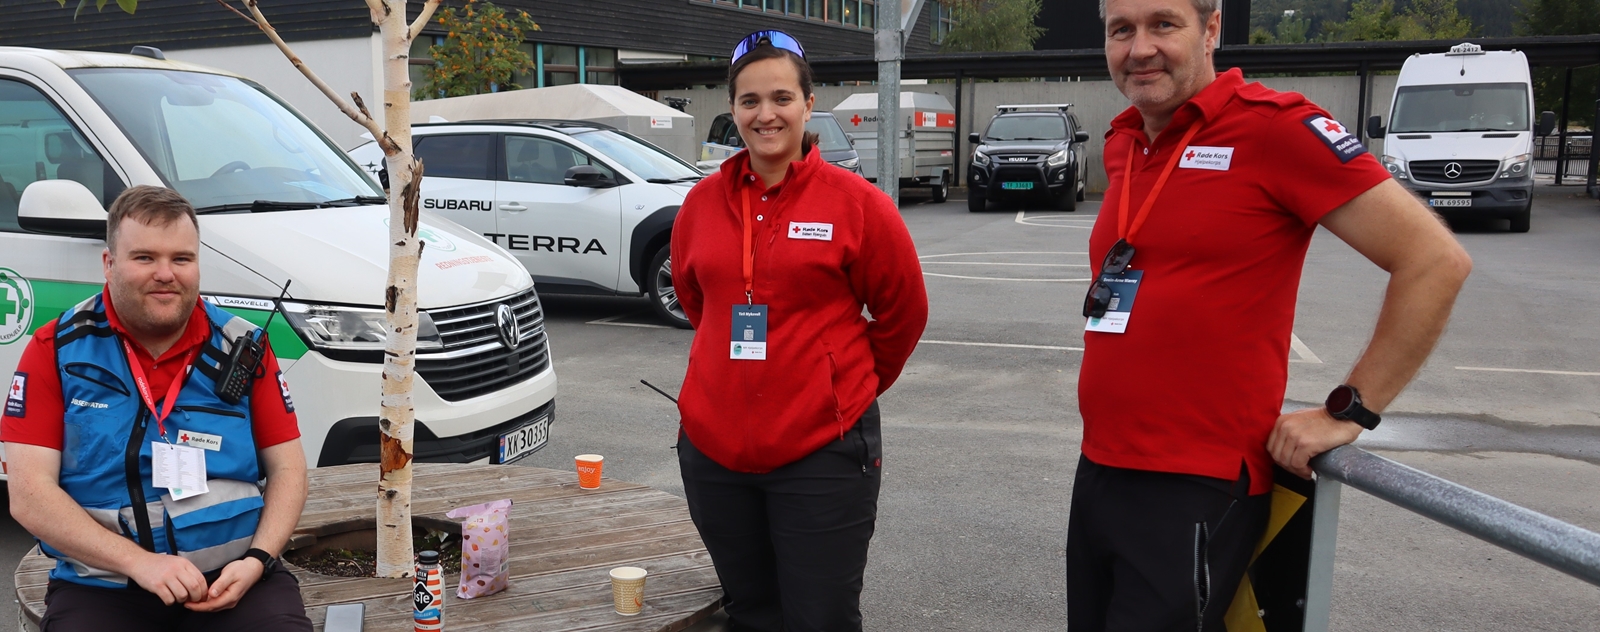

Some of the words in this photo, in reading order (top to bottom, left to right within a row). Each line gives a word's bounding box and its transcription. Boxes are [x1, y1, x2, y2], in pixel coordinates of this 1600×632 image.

[1196, 151, 1213, 159] Røde
[1213, 152, 1228, 160] Kors
[424, 198, 492, 212] SUBARU
[223, 298, 269, 307] CARAVELLE
[577, 465, 596, 474] enjoy
